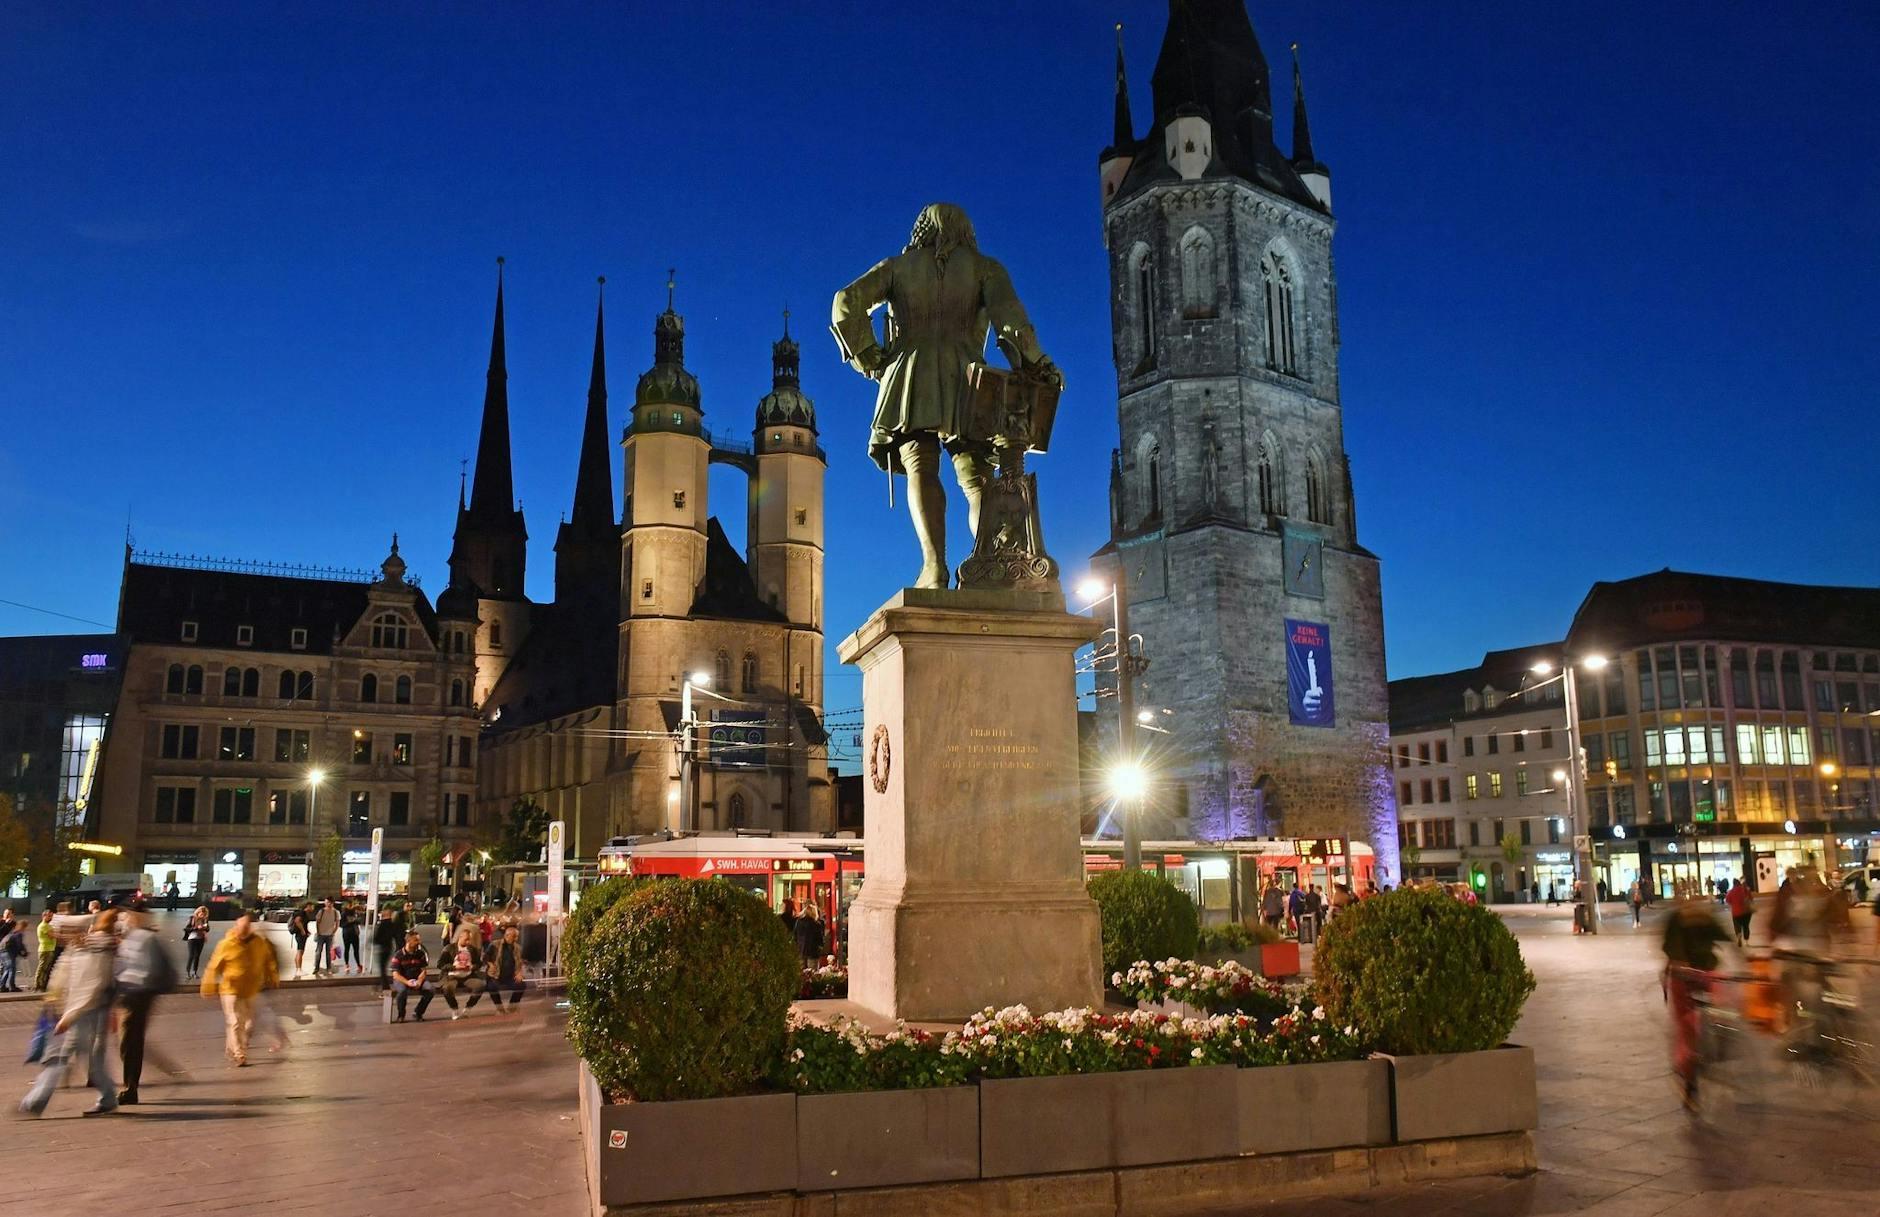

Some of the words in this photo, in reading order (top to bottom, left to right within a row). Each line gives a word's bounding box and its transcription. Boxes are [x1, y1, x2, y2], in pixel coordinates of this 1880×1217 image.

[1297, 625, 1318, 636] KEINE
[717, 859, 739, 870] SWH.
[741, 859, 770, 870] HAVAG
